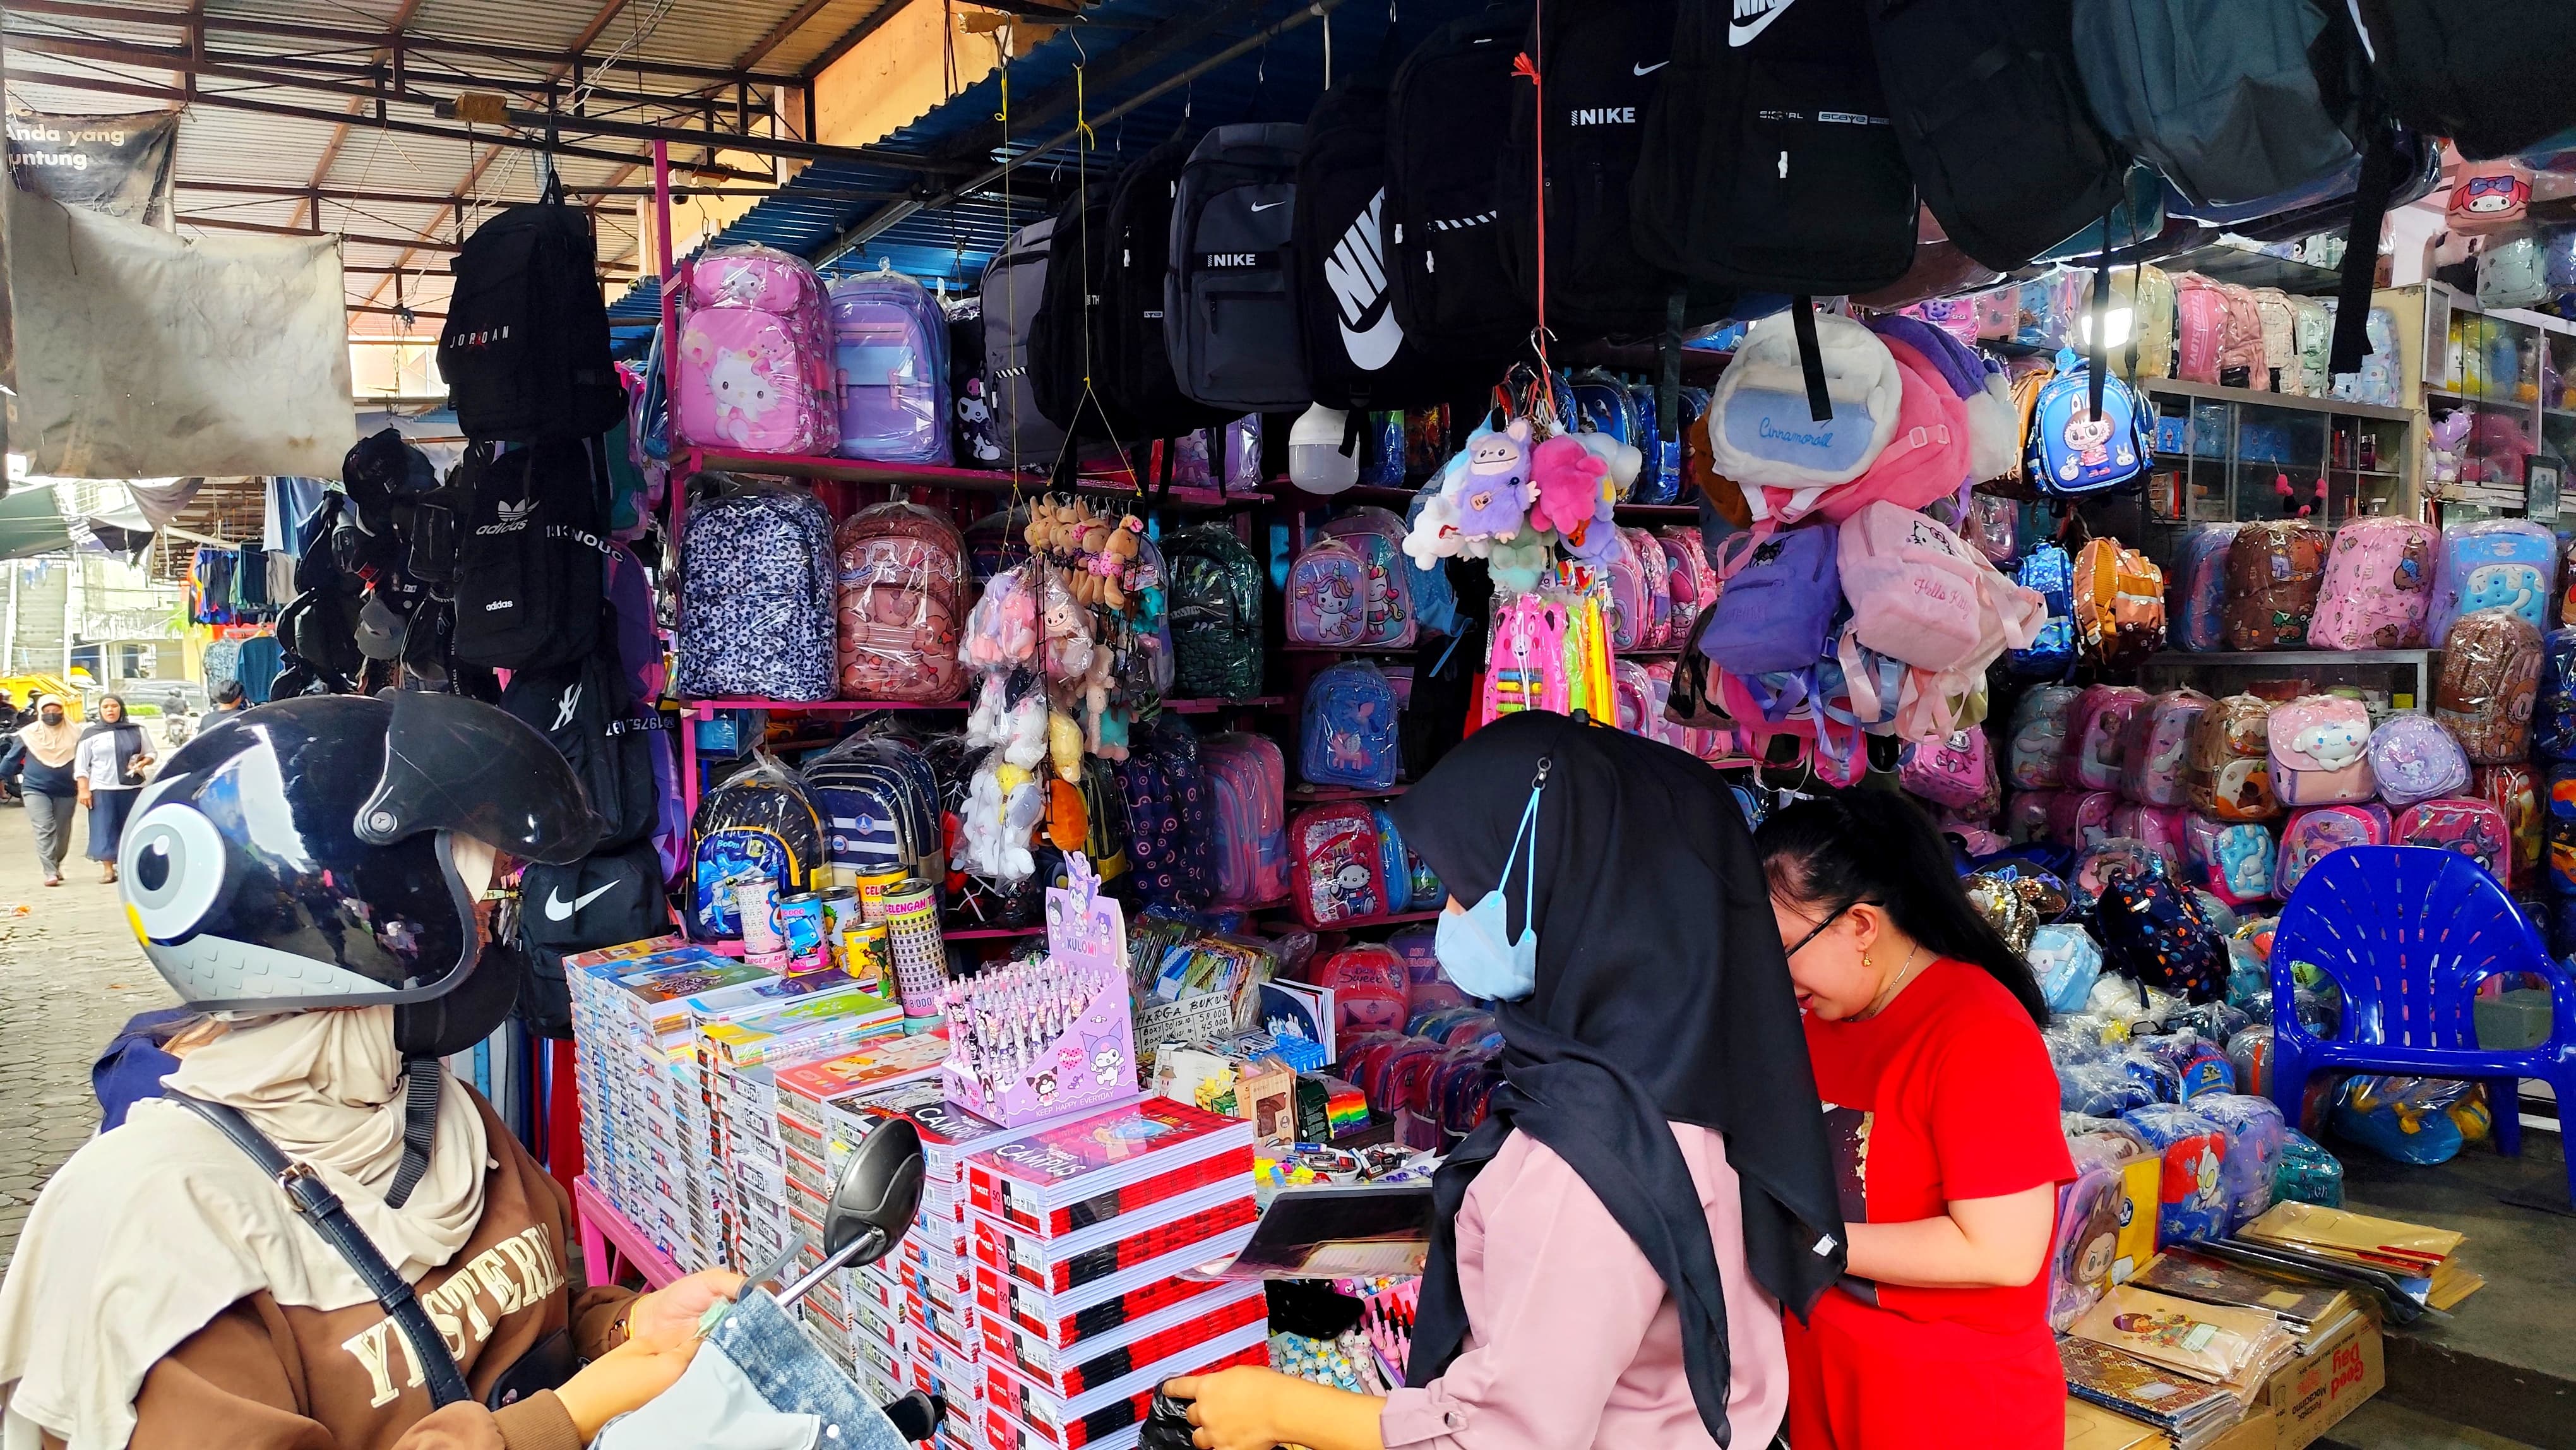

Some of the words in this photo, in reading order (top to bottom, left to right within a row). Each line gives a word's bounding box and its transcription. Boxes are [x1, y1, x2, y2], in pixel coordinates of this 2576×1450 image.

[1580, 107, 1636, 125] NIKE
[6, 124, 61, 141] Anda
[68, 130, 125, 147] yang
[1213, 254, 1256, 267] NIKE
[450, 325, 509, 349] JORDAN
[476, 518, 528, 536] adidas
[1914, 578, 1946, 601] Hello
[486, 600, 513, 612] adidas
[885, 897, 926, 913] CELENGAN
[1409, 948, 1426, 957] MY
[1135, 1007, 1182, 1028] HARGA
[1190, 995, 1222, 1012] BUKU
[1143, 1025, 1162, 1036] BOXY
[1165, 1022, 1173, 1031] 50
[1144, 1034, 1162, 1046] BOXY
[1035, 1106, 1053, 1117] KEEP
[1055, 1101, 1077, 1111] HAPPY
[1080, 1091, 1114, 1106] EVERYDAY
[996, 1144, 1087, 1177] CAMPUS
[992, 1190, 1001, 1202] 50
[1003, 1194, 1011, 1206] 10
[921, 1252, 928, 1264] 36
[1008, 1249, 1016, 1261] 10
[999, 1291, 1008, 1304] 50
[1010, 1297, 1018, 1310] 10
[1015, 1345, 1023, 1358] 10
[2332, 1341, 2360, 1374] Day
[2330, 1360, 2364, 1400] Good
[1010, 1392, 1019, 1405] 50
[1020, 1398, 1029, 1412] 10
[1007, 1436, 1016, 1450] 50
